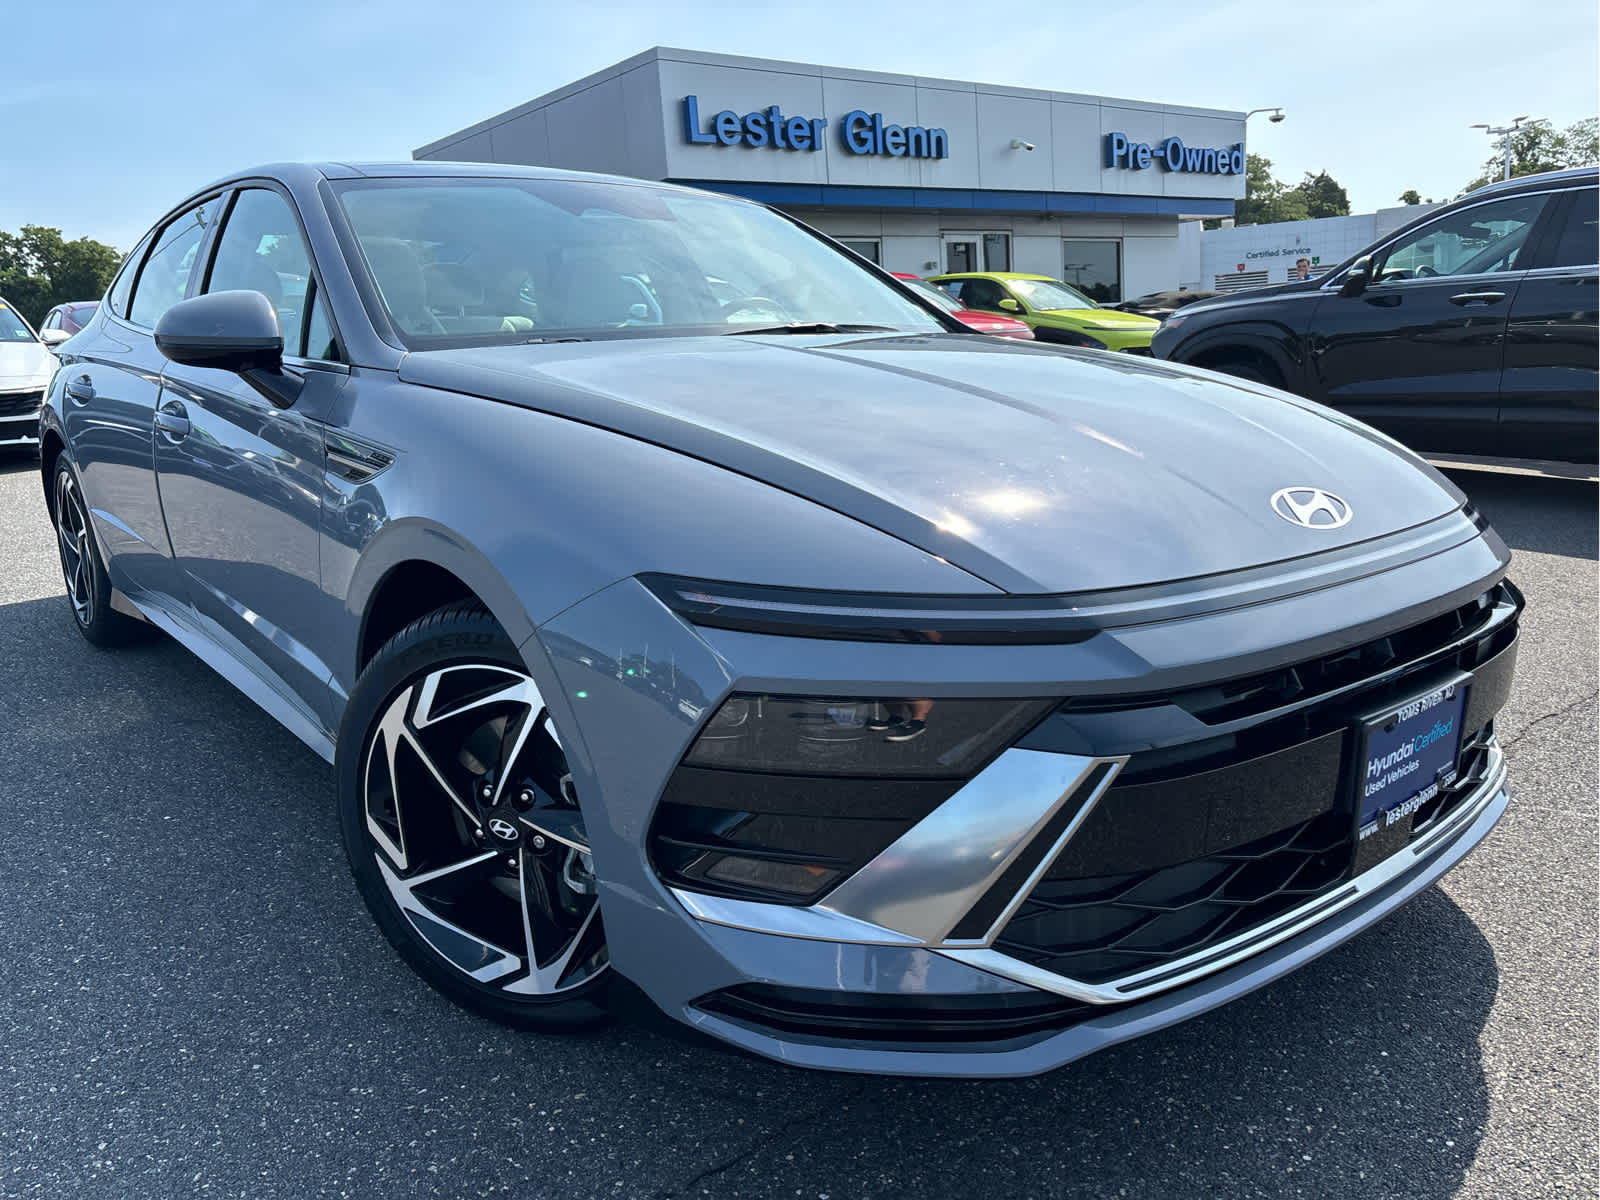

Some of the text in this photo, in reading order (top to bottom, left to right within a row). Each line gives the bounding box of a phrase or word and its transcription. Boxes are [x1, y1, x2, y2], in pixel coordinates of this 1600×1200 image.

[683, 95, 949, 159] Lester Glenn
[1105, 132, 1244, 175] Pre-Owned
[1246, 248, 1311, 259] Certified Service
[1364, 774, 1387, 797] Used
[1387, 760, 1420, 785] Vehicles
[1366, 738, 1415, 779] Hyundai
